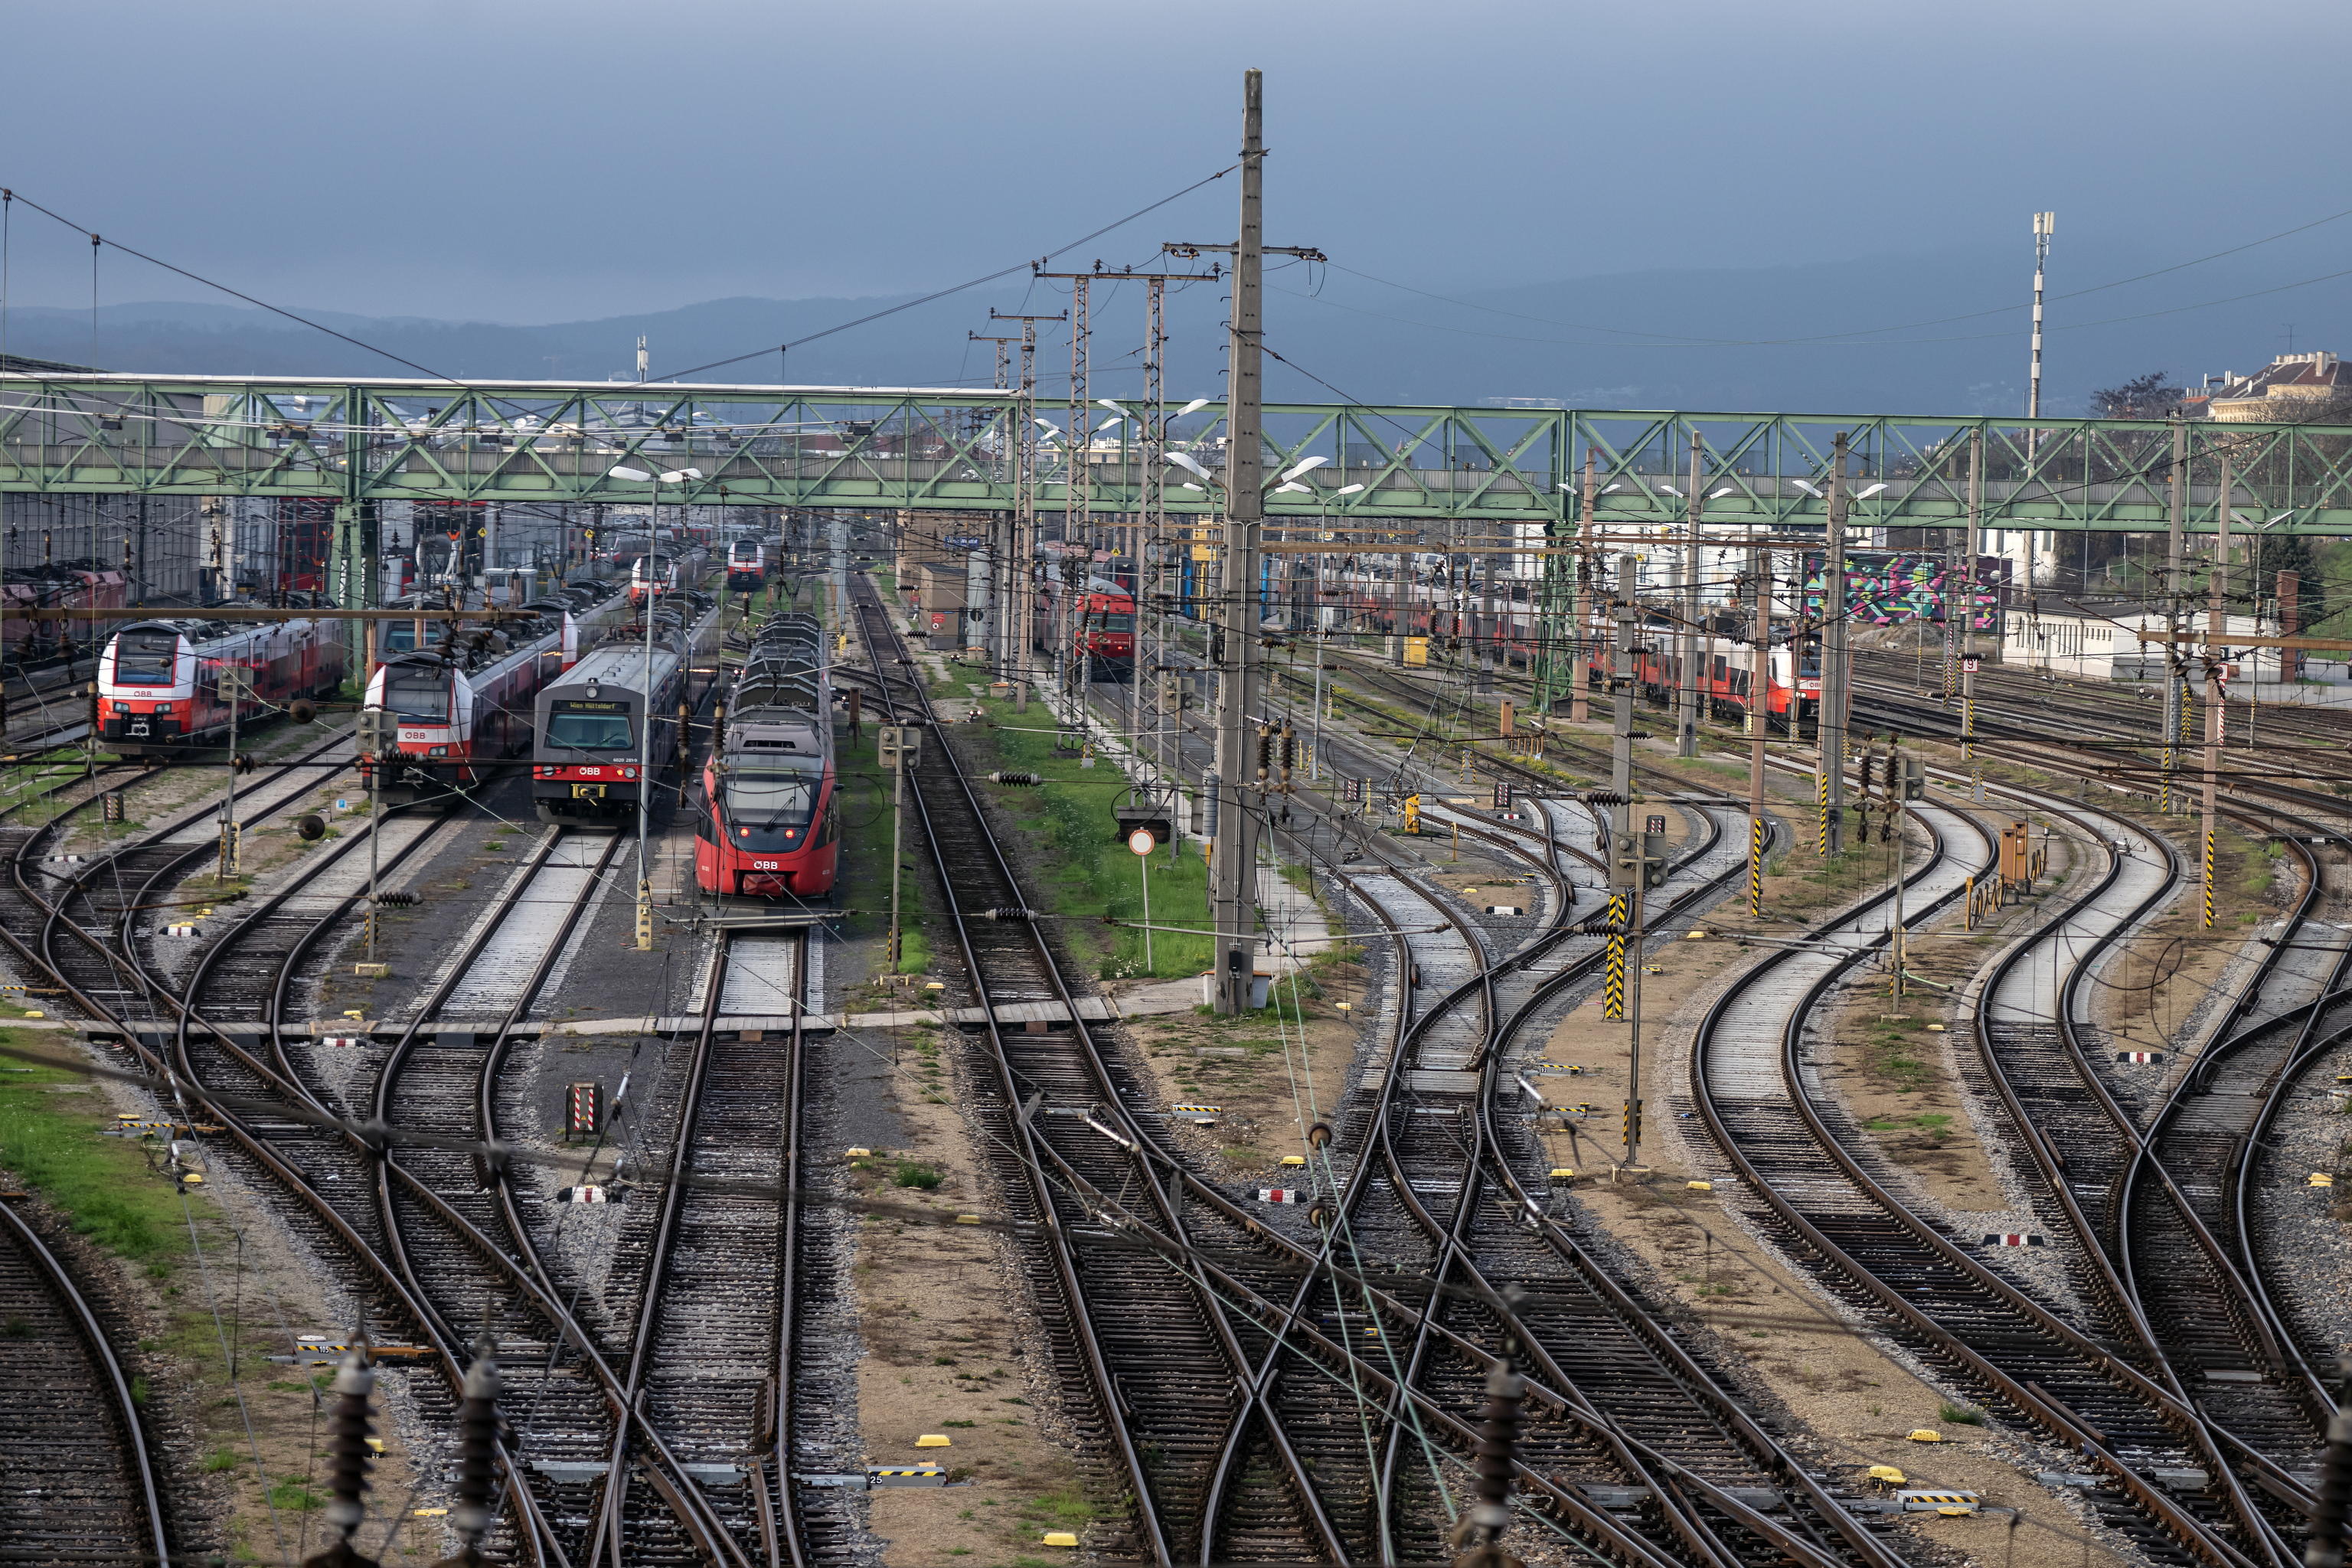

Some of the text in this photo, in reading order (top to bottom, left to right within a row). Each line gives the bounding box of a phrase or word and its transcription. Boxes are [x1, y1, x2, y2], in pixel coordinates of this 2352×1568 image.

[1968, 659, 1974, 669] 9
[405, 731, 426, 740] ÖBB
[579, 767, 600, 776] ÖBB
[753, 861, 778, 870] ÖBB
